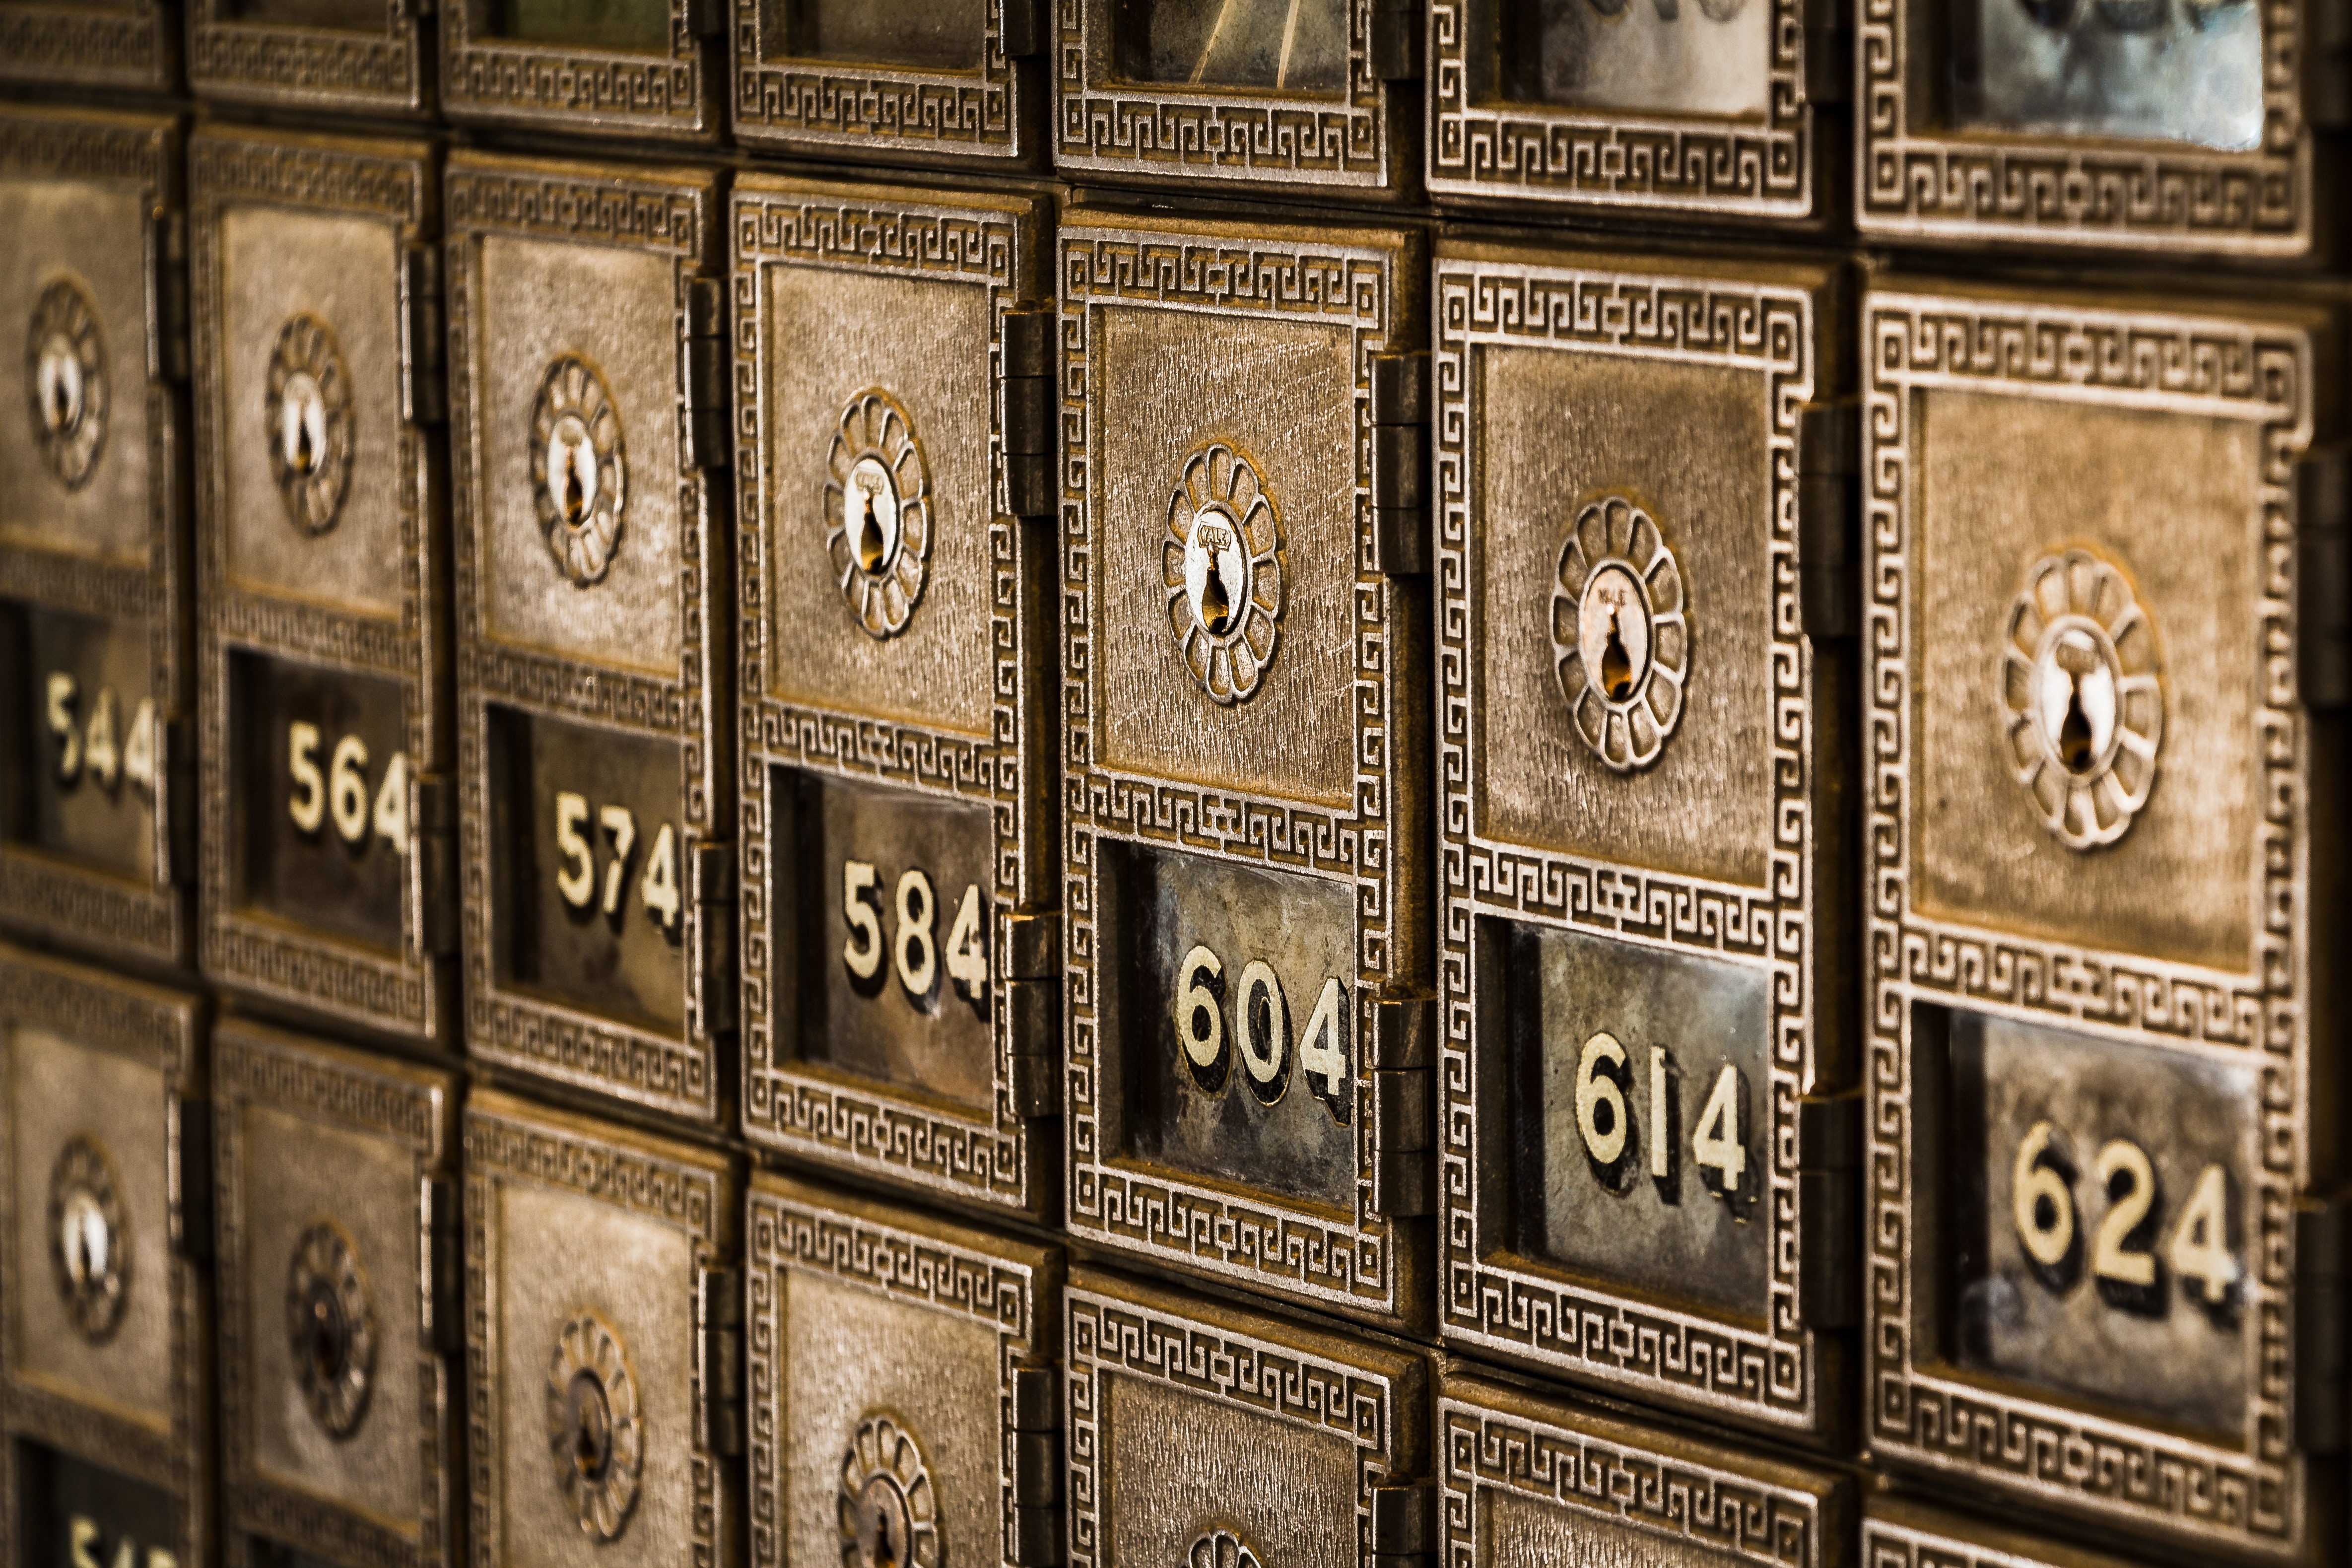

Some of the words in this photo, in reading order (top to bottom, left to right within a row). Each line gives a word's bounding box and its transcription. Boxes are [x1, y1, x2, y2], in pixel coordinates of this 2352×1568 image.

[47, 671, 156, 789] 544
[288, 720, 411, 855] 564
[556, 791, 679, 927] 574
[844, 860, 987, 999] 584
[1176, 945, 1347, 1097] 604
[1575, 1032, 1746, 1192] 614
[2013, 1120, 2237, 1301] 624
